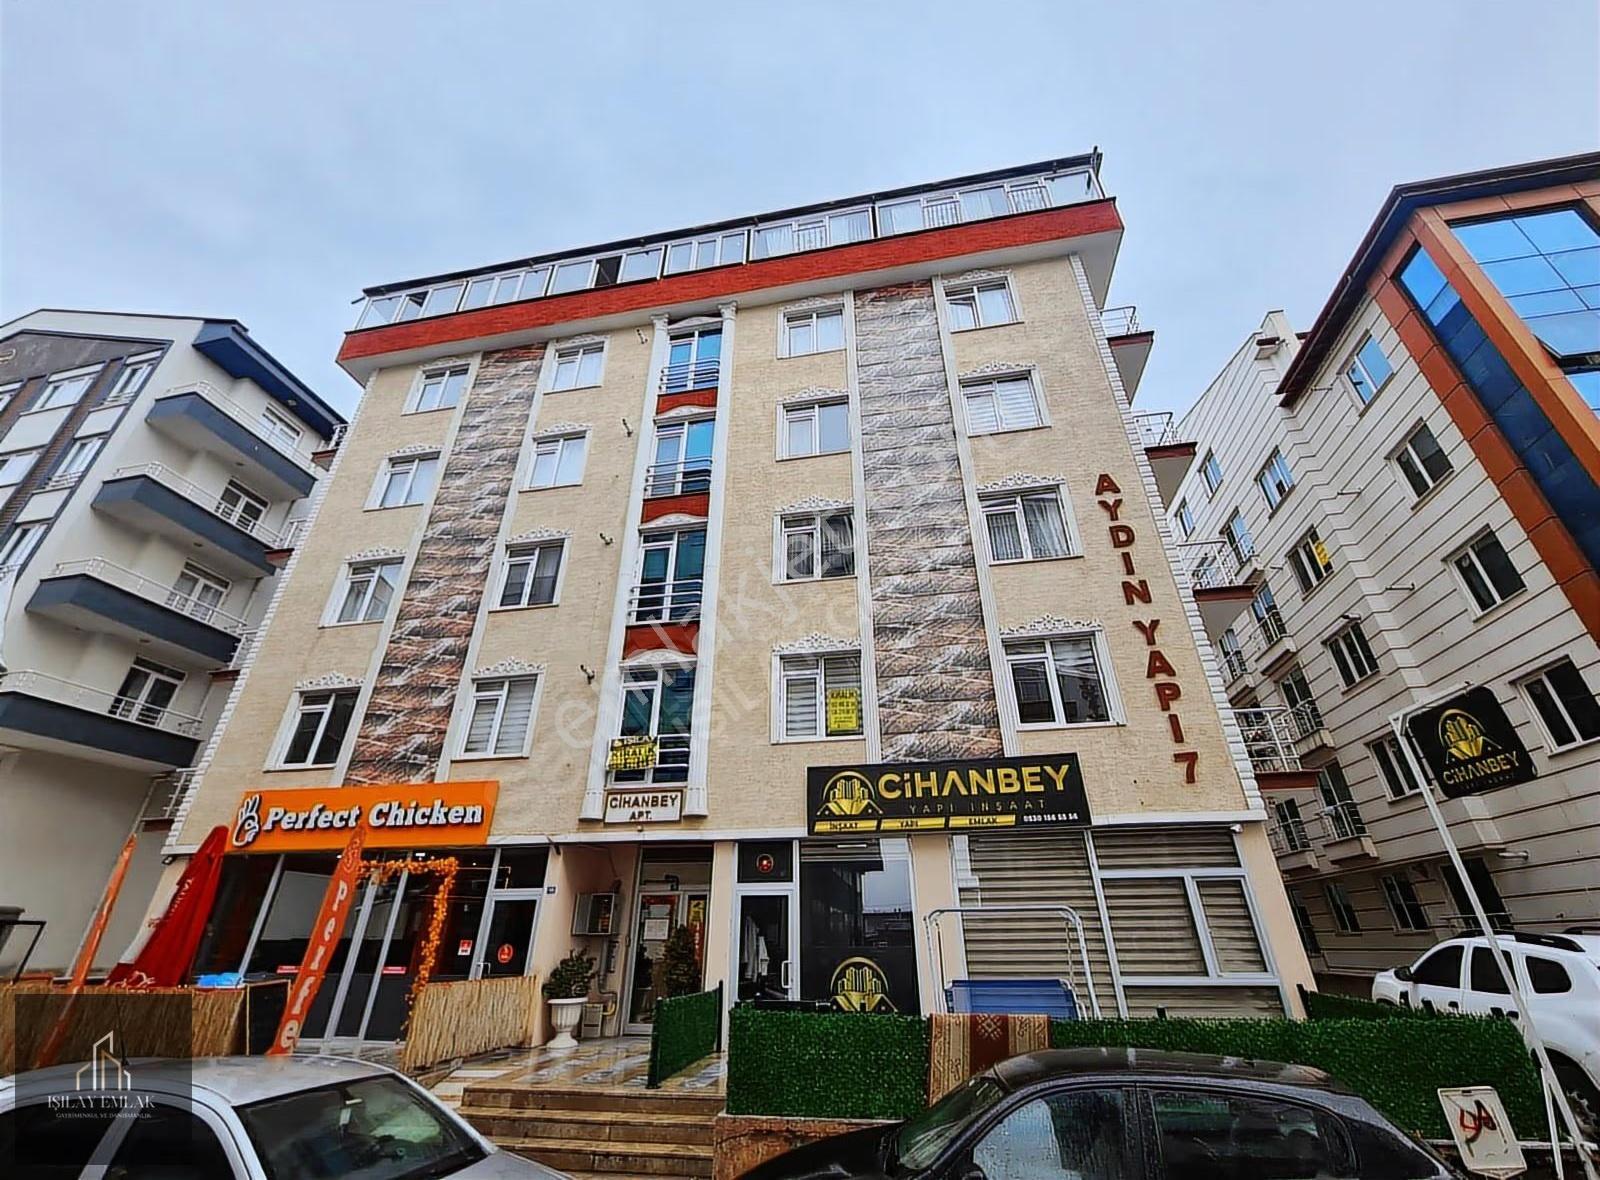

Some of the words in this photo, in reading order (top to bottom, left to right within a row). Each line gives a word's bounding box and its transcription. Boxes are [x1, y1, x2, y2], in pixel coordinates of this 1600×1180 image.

[1095, 473, 1152, 605] AYDIN
[1132, 619, 1184, 743] YAPI
[1173, 751, 1198, 784] 7
[262, 804, 360, 830] Perfect
[368, 799, 483, 827] Chicken
[909, 803, 955, 814] YAPI
